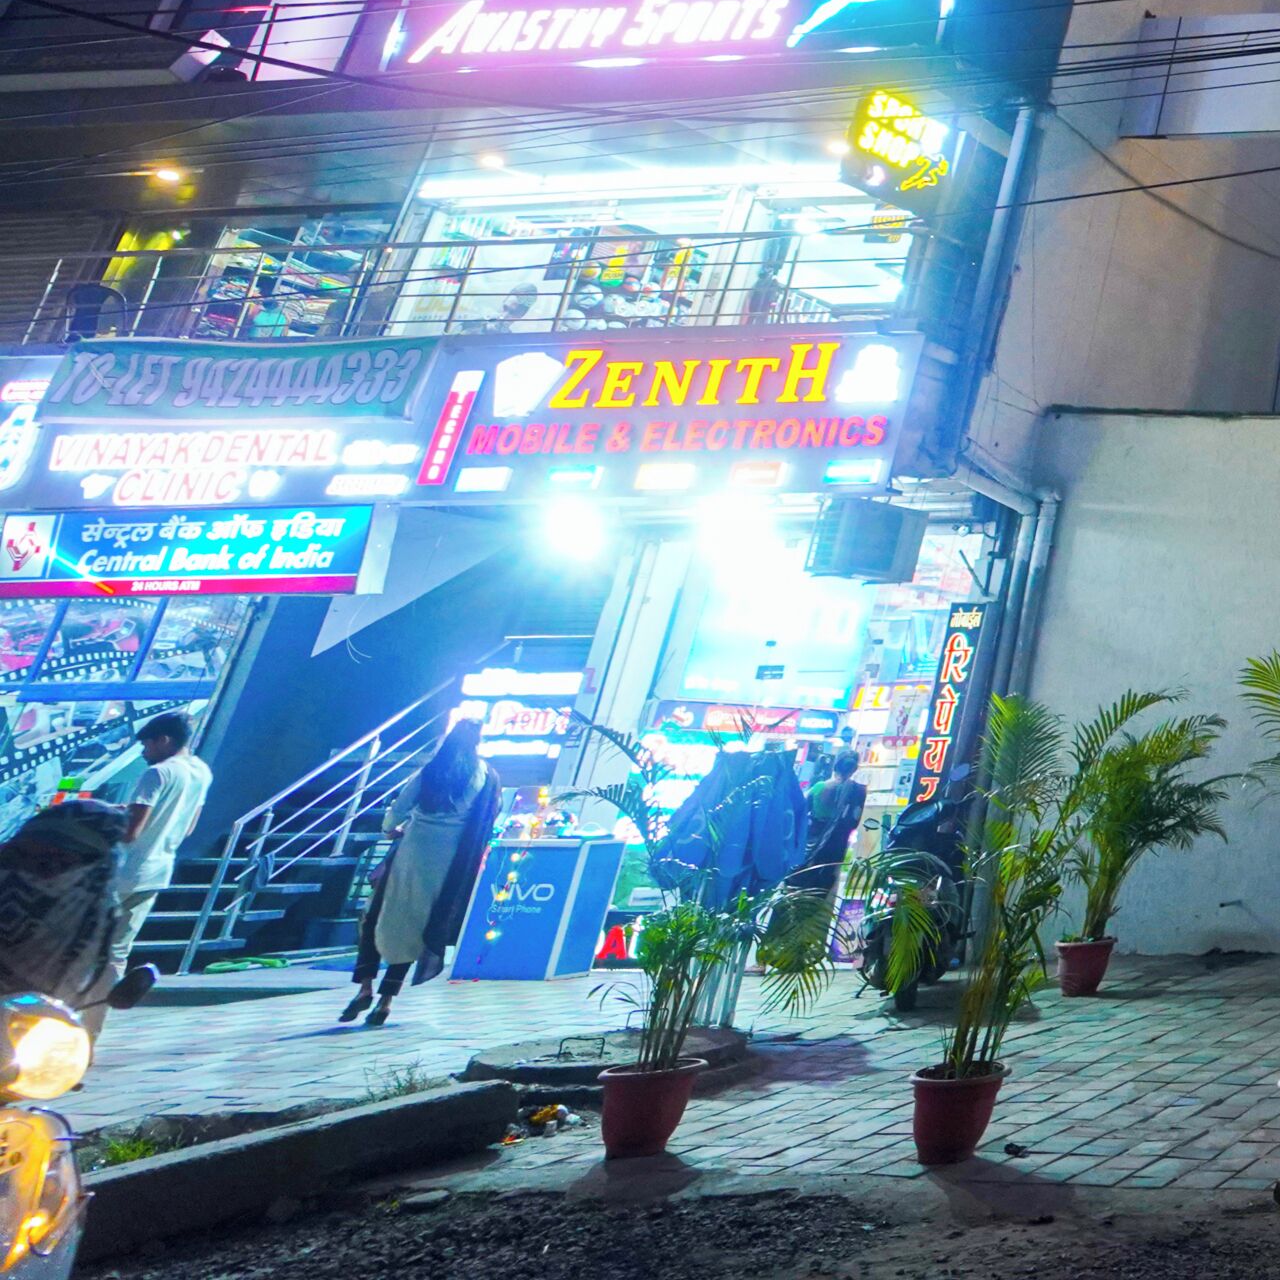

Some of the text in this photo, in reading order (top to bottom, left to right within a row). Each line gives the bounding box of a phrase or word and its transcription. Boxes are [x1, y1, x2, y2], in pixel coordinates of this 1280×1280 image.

[407, 0, 627, 63] AWASTHY
[549, 342, 839, 409] ZENITH
[54, 435, 199, 468] VINAYAK
[200, 431, 333, 464] DENTAL
[467, 415, 887, 455] MOBILE & ELECTRONICS
[117, 470, 239, 502] CLINIC
[158, 516, 205, 540] बैंक
[77, 543, 334, 573] Central Bank of India
[131, 581, 143, 591] 24
[144, 581, 178, 591] HOURS
